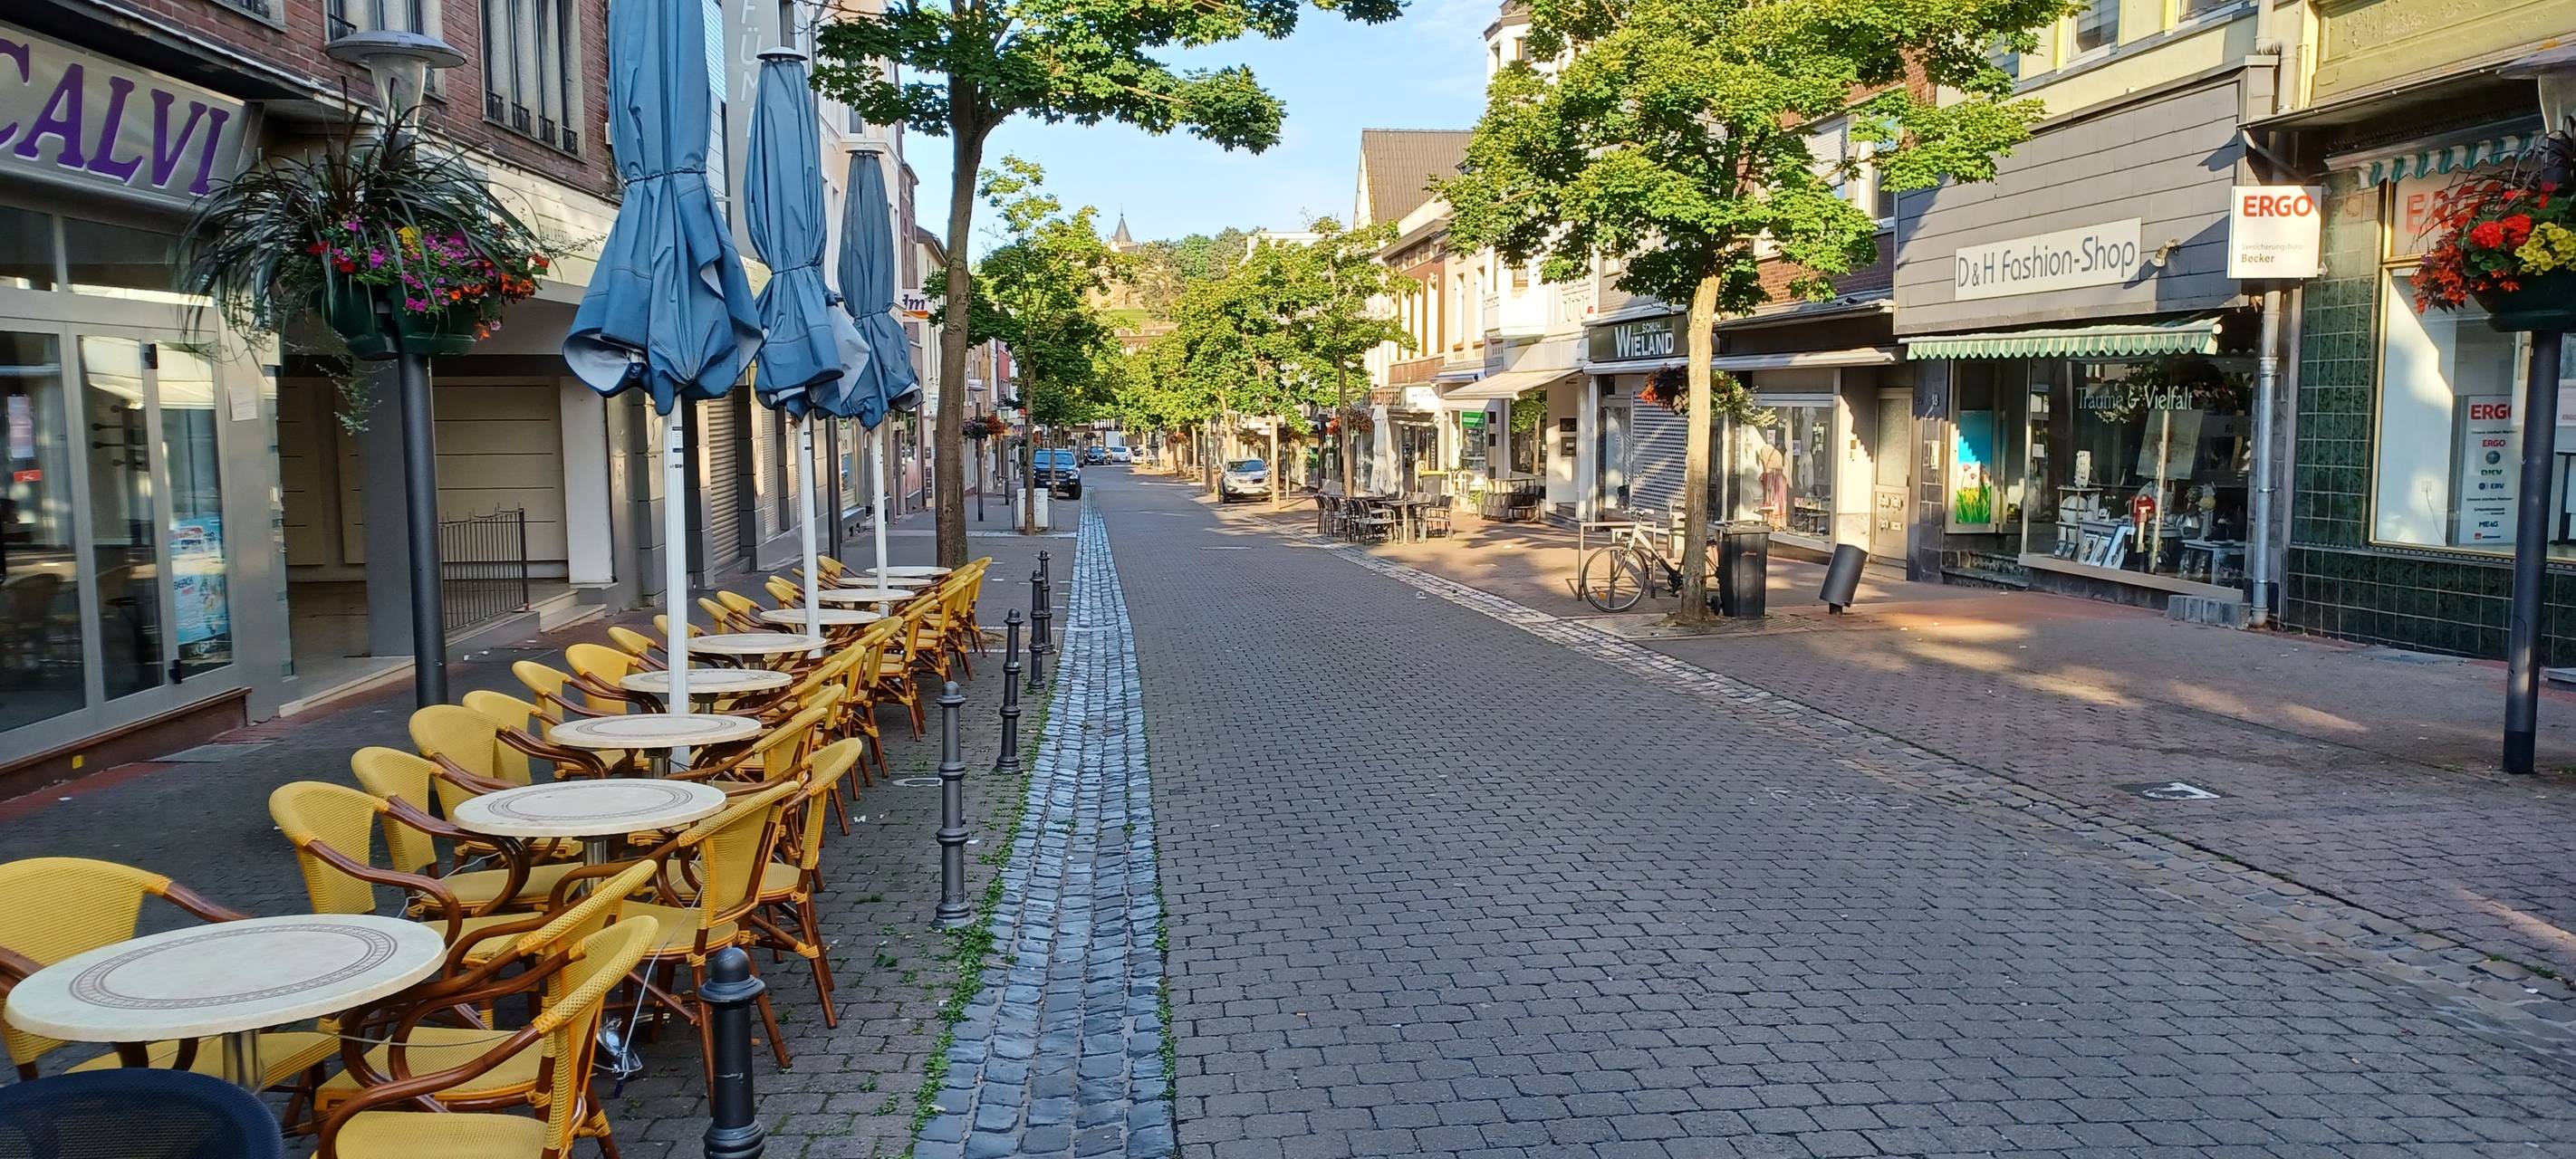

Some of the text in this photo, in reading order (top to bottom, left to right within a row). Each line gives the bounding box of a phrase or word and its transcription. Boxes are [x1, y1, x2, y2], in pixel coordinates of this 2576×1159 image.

[2243, 195, 2312, 217] ERGO
[1957, 235, 2136, 288] D & H Fashion-Shop
[2241, 254, 2275, 263] Becker
[1641, 321, 1661, 333] SCHUH
[2127, 385, 2140, 409] &
[2143, 385, 2193, 410] Vielfalt
[2471, 404, 2513, 420] ERG
[2482, 439, 2506, 447] ERGO
